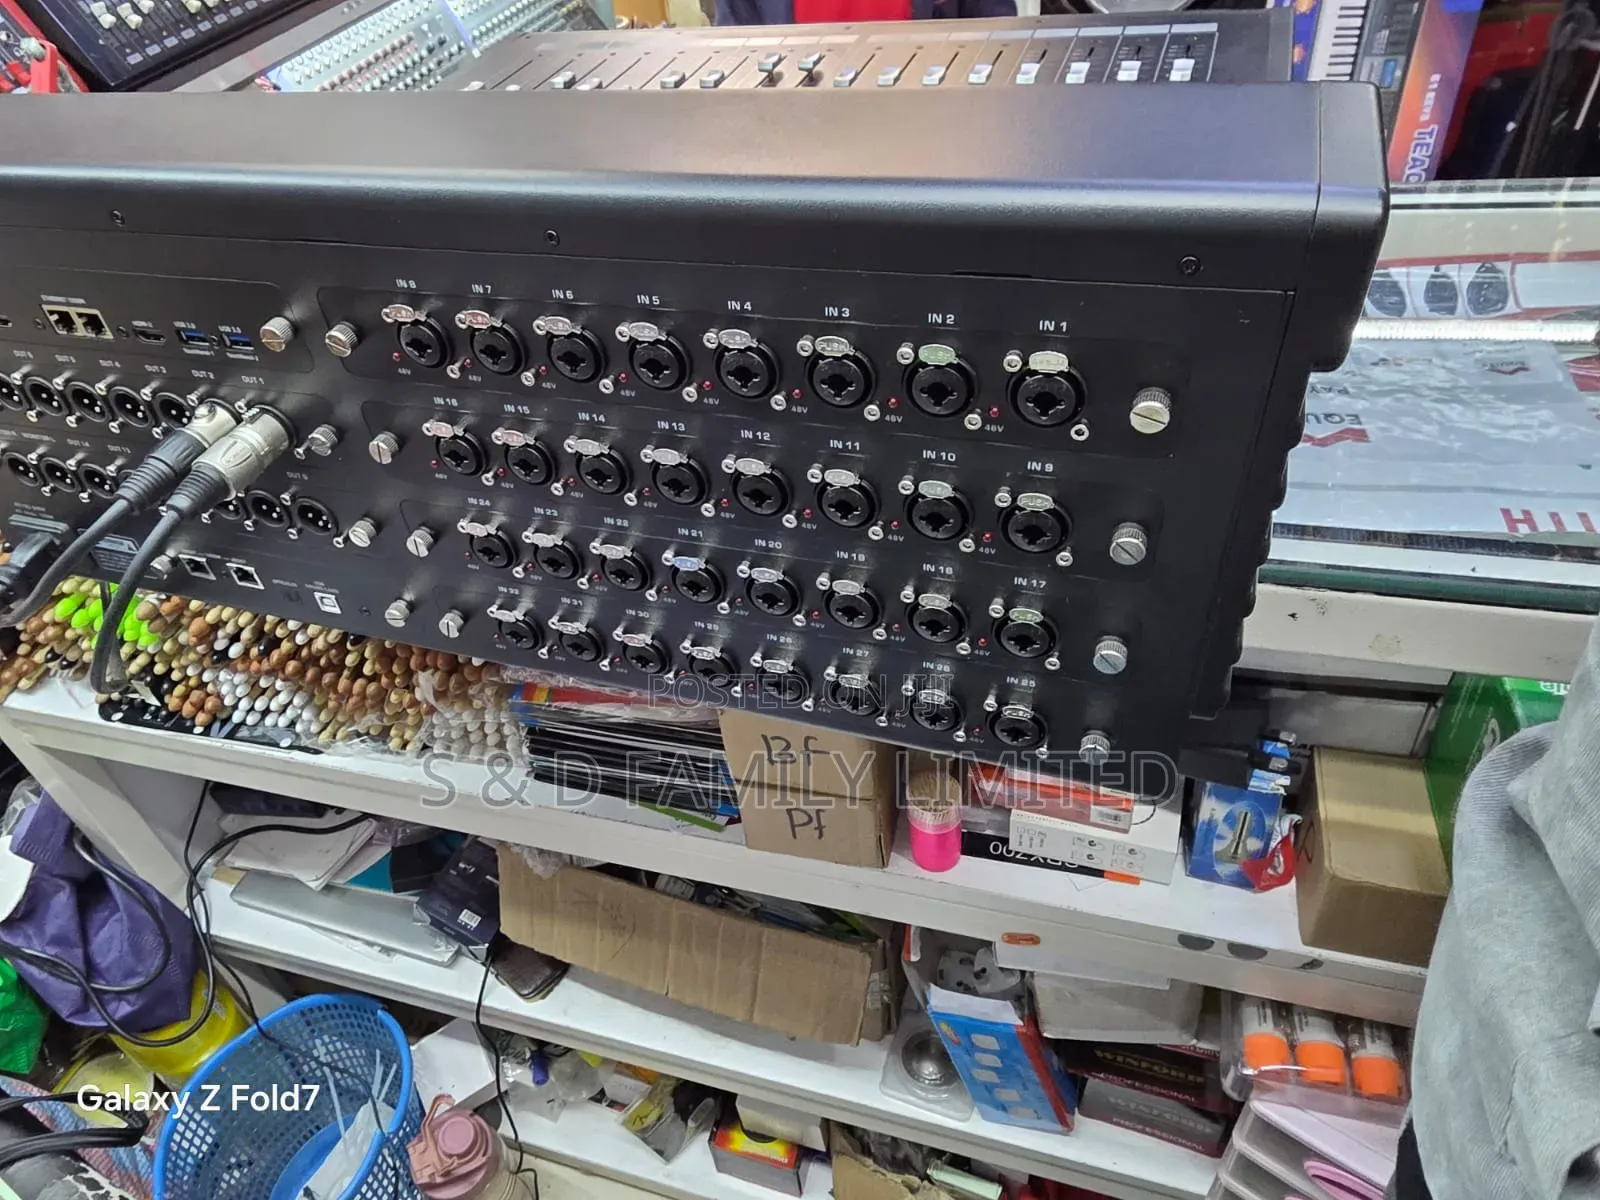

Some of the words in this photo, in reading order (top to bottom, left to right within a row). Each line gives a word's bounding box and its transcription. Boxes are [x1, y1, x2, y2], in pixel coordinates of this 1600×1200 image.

[395, 279, 408, 288] IN
[471, 283, 483, 294] IN
[484, 285, 492, 294] 7
[551, 289, 564, 299] IN
[566, 290, 574, 300] 6
[637, 294, 650, 305] IN
[652, 296, 660, 305] 5
[727, 300, 741, 311] IN
[743, 301, 752, 311] 4
[824, 306, 838, 317] IN
[841, 307, 850, 318] 3
[928, 313, 942, 324] IN
[946, 314, 955, 324] 2
[1039, 320, 1055, 331] IN
[1060, 321, 1068, 332] 1
[433, 396, 444, 405] IN
[504, 404, 515, 413] IN
[517, 405, 530, 414] 15
[791, 406, 808, 414] 48V
[578, 412, 590, 421] IN
[592, 413, 606, 423] 14
[884, 414, 903, 423] 48V
[657, 420, 669, 430] IN
[671, 421, 686, 431] 13
[741, 429, 753, 439] IN
[756, 431, 771, 441] 12
[829, 439, 843, 449] IN
[845, 441, 860, 451] 11
[922, 449, 936, 459] IN
[940, 452, 956, 462] 10
[1027, 461, 1042, 472] IN
[467, 497, 477, 505] IN
[478, 498, 491, 507] 24
[534, 506, 544, 515] IN
[603, 517, 614, 525] IN
[677, 527, 689, 536] IN
[754, 538, 766, 547] IN
[768, 540, 782, 549] 20
[836, 550, 849, 559] IN
[922, 563, 935, 573] IN
[1014, 576, 1027, 586] IN
[1030, 579, 1047, 589] 17
